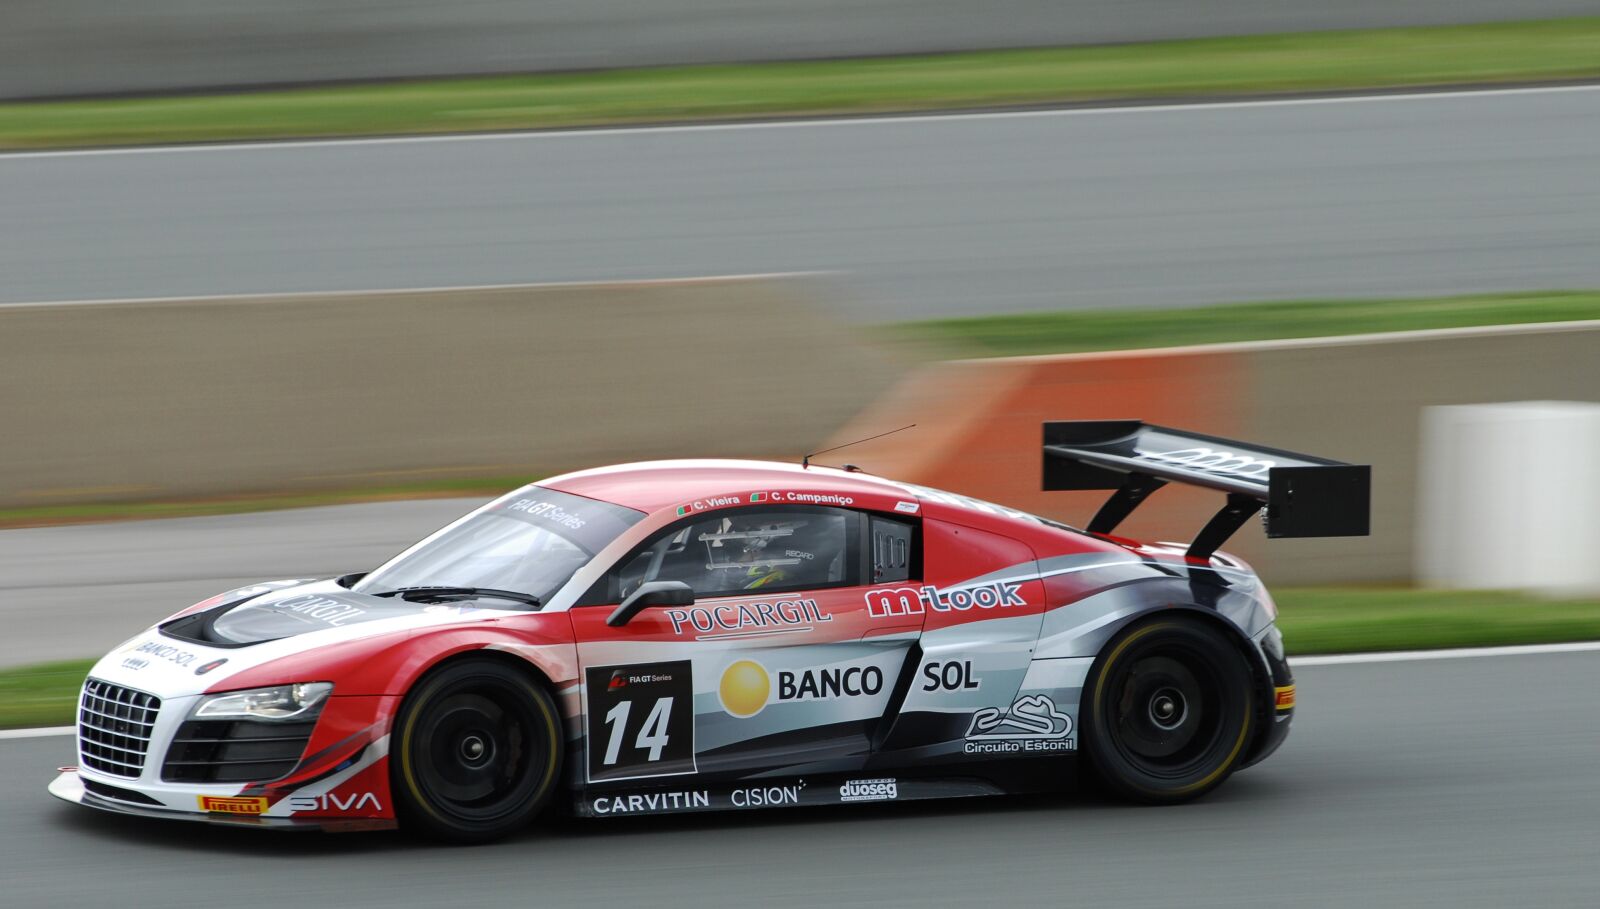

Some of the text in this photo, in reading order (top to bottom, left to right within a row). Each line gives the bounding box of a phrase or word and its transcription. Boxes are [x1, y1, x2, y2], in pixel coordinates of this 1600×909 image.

[708, 495, 740, 509] Vieira
[787, 492, 854, 505] Campaniço
[527, 502, 557, 515] GT
[544, 507, 586, 529] Series
[664, 599, 832, 634] POCARGIL
[641, 675, 652, 683] GT
[651, 674, 672, 682] Series
[778, 661, 979, 700] BANCO SOL
[602, 696, 674, 766] 14
[964, 738, 1073, 754] Circuito Estoril
[731, 785, 798, 807] CISION
[840, 780, 898, 799] duoseg
[202, 796, 260, 813] PIRELLI
[290, 792, 382, 812] SIVA
[593, 790, 710, 814] CARVITIN
